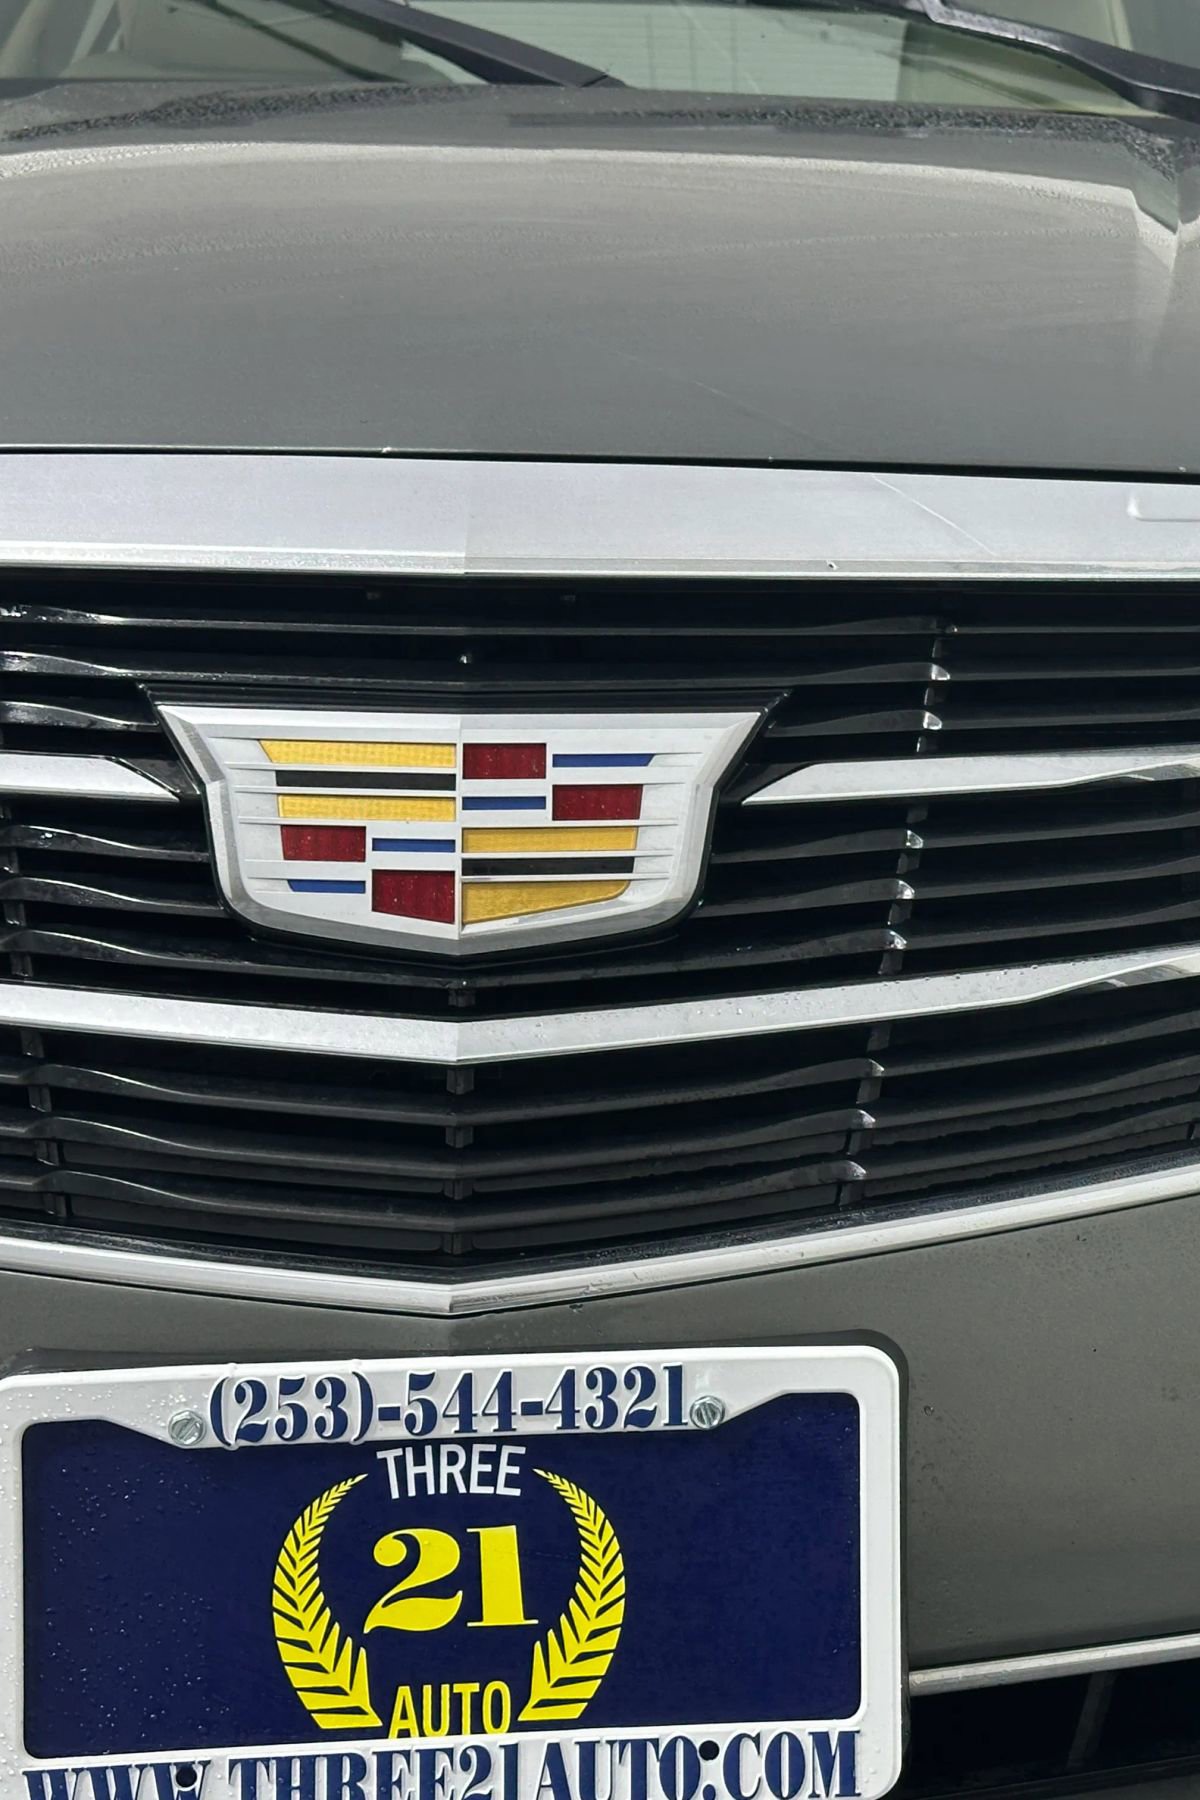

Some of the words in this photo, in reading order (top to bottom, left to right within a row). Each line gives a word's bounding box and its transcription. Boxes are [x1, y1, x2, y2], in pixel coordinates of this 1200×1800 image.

[208, 1364, 689, 1447] (253)-544-4321
[376, 1443, 527, 1500] THREE
[363, 1524, 539, 1634] 21
[388, 1680, 511, 1739] AUTO
